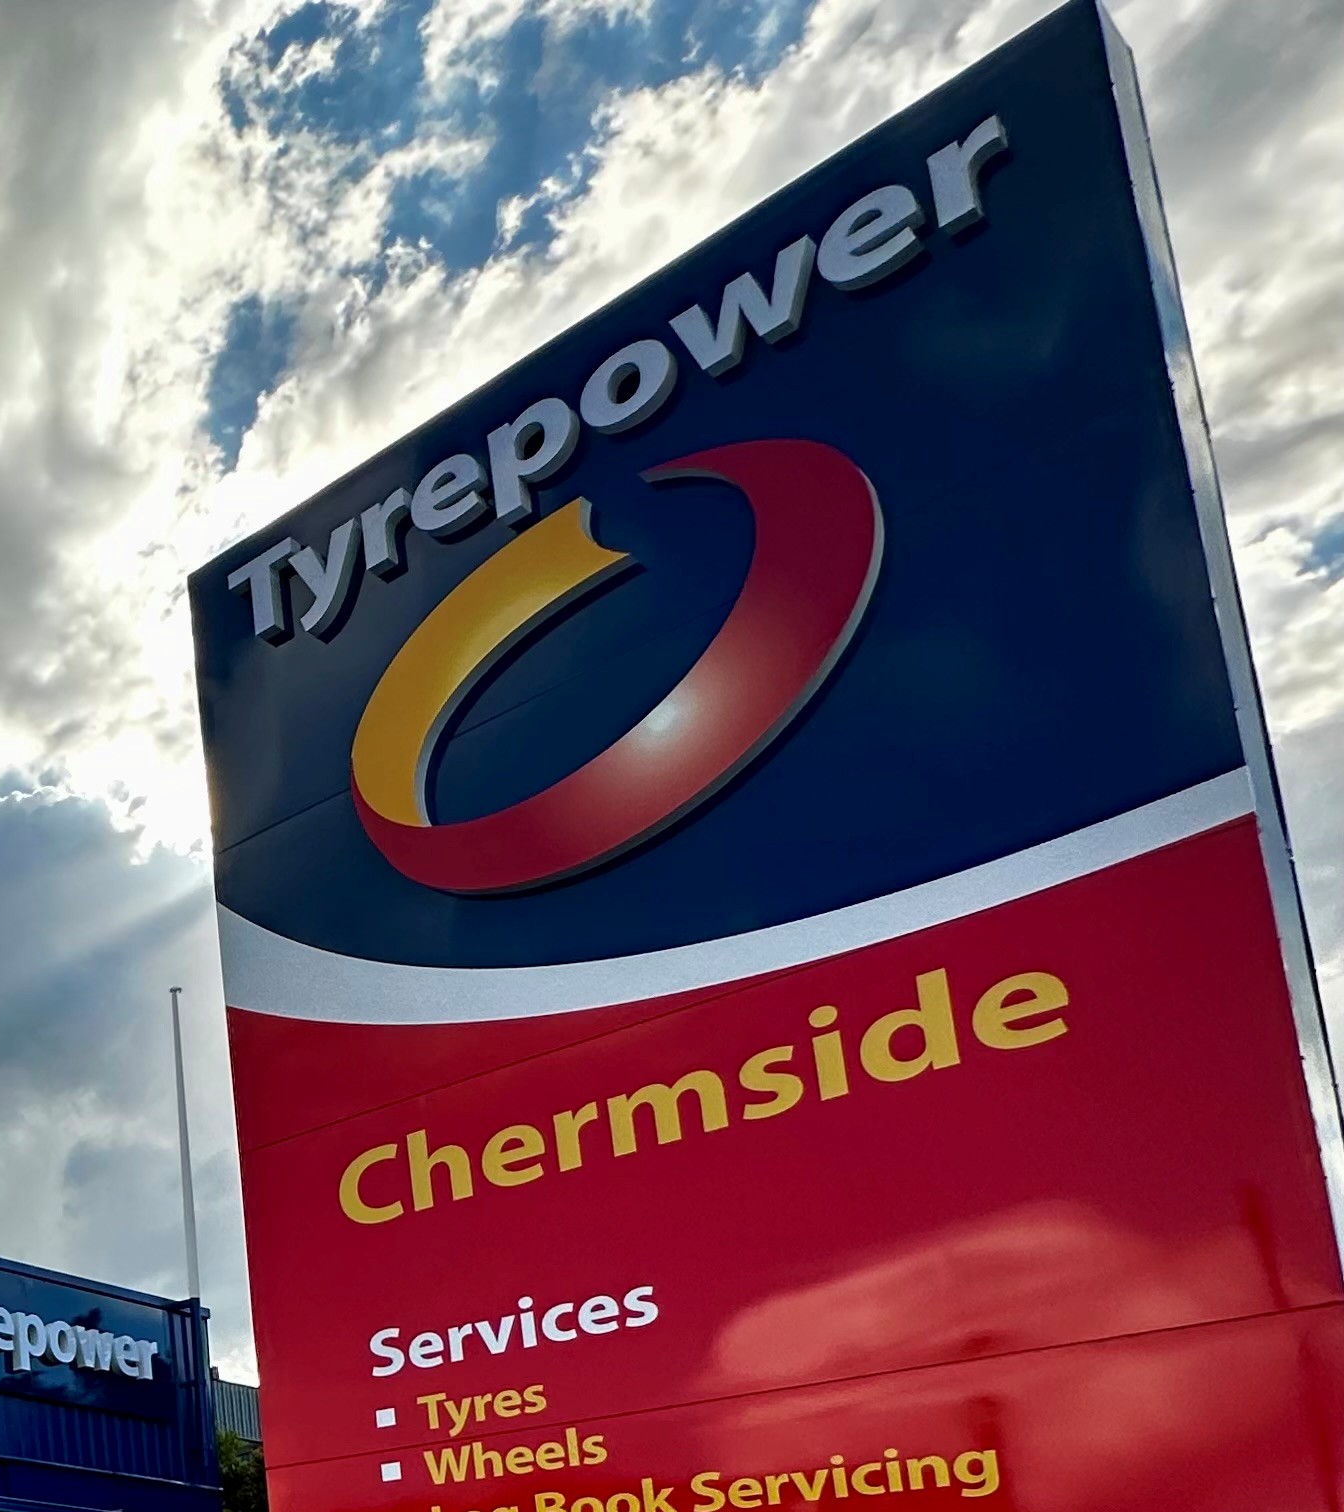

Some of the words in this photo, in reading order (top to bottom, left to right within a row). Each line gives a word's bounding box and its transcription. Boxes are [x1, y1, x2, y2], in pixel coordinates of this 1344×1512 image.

[227, 113, 1008, 645] Tyrepower
[337, 968, 1071, 1225] Chermside
[369, 1286, 659, 1377] Services
[417, 1384, 547, 1437] Tyres
[423, 1427, 608, 1485] Wheels
[691, 1448, 1001, 1512] Servicing
